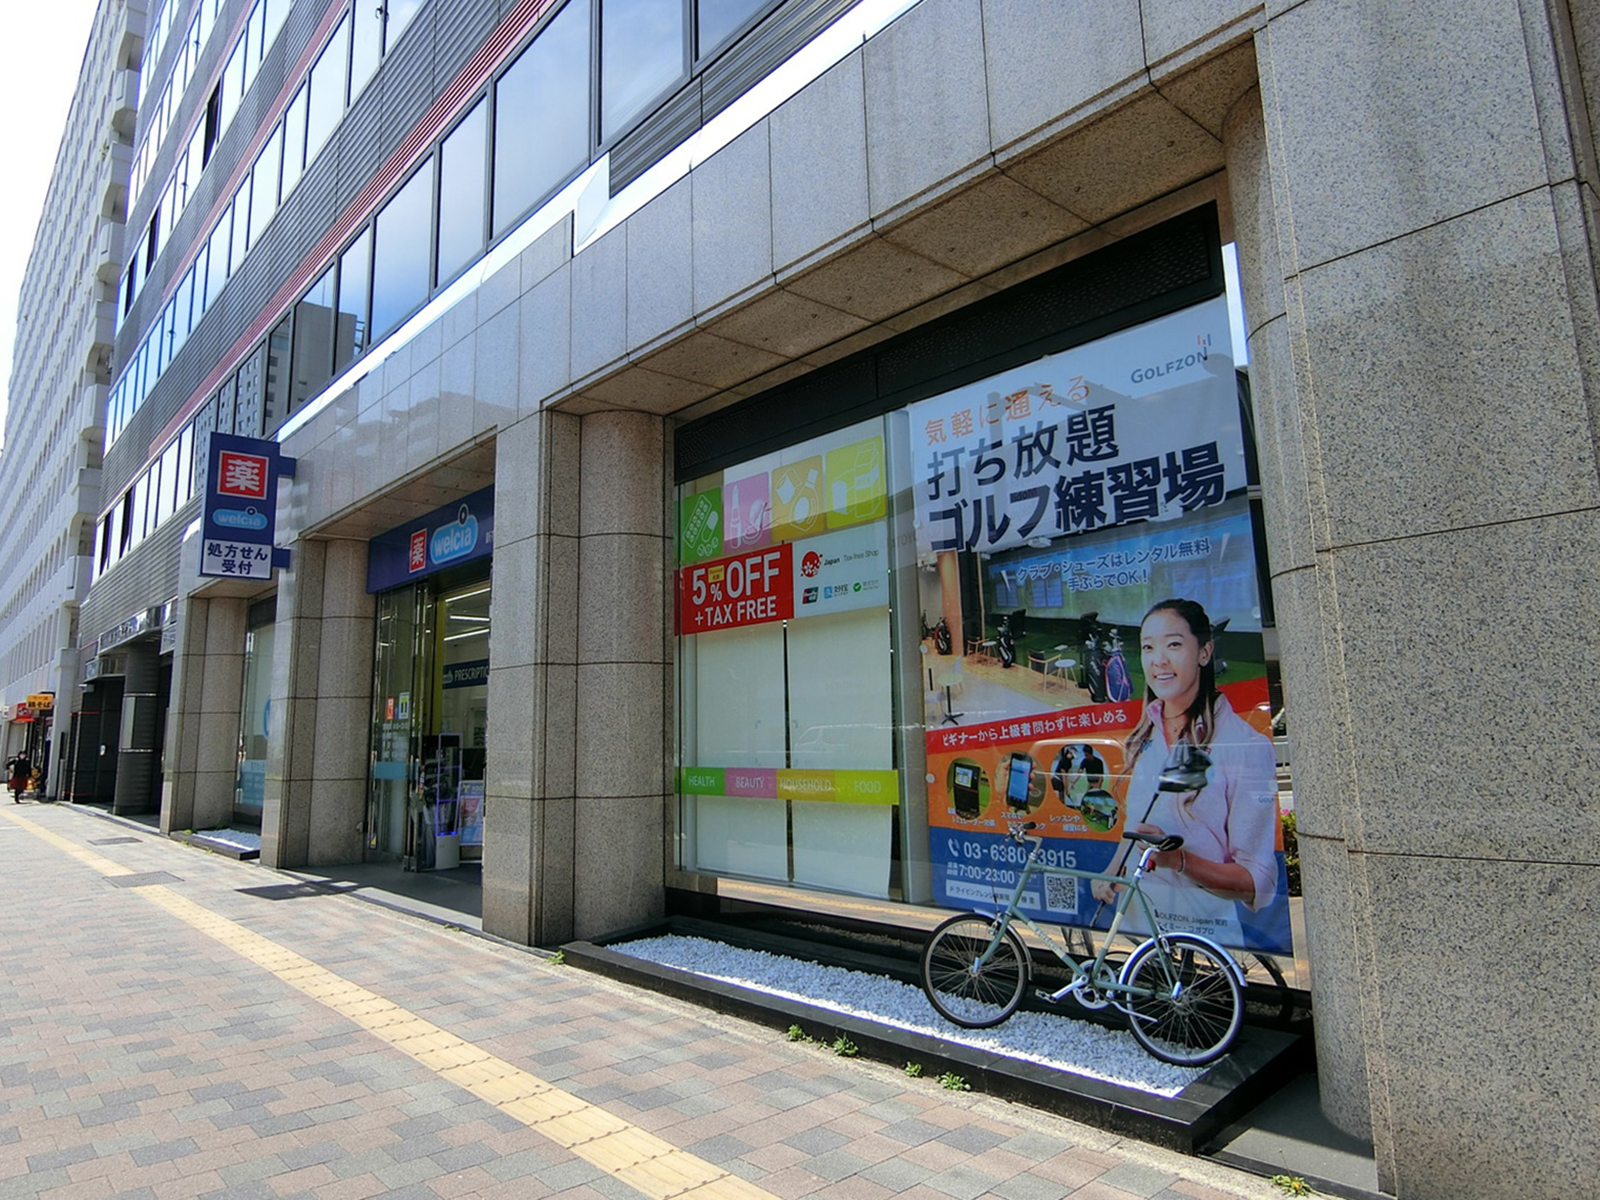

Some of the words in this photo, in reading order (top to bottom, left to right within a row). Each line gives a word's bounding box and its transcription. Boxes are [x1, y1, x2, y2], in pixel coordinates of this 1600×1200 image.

[1131, 346, 1208, 384] GOLFZON
[924, 375, 1091, 446] 気軽に通える
[926, 403, 1120, 501] 打ち放題
[226, 459, 260, 491] 薬
[928, 440, 1226, 552] ゴルフ練習場
[218, 512, 261, 527] welcia
[207, 542, 268, 562] 処方せん
[434, 526, 472, 557] welcia
[222, 559, 253, 575] 受付
[1016, 537, 1211, 582] クラブ・シューズはレンタル無料
[726, 551, 780, 598] OFF
[1067, 569, 1150, 592] 手ぶらでOK！
[737, 595, 777, 621] FREE
[942, 709, 1127, 747] ビギナーから上級者問わずに楽しめる
[688, 776, 715, 787] HEALTH
[735, 776, 765, 789] BEAUTY
[779, 779, 831, 792] HOUSEHOLD
[854, 780, 881, 793] FOOD
[963, 841, 1077, 868] 03-63803915
[959, 864, 1015, 884] 7:00-23:00
